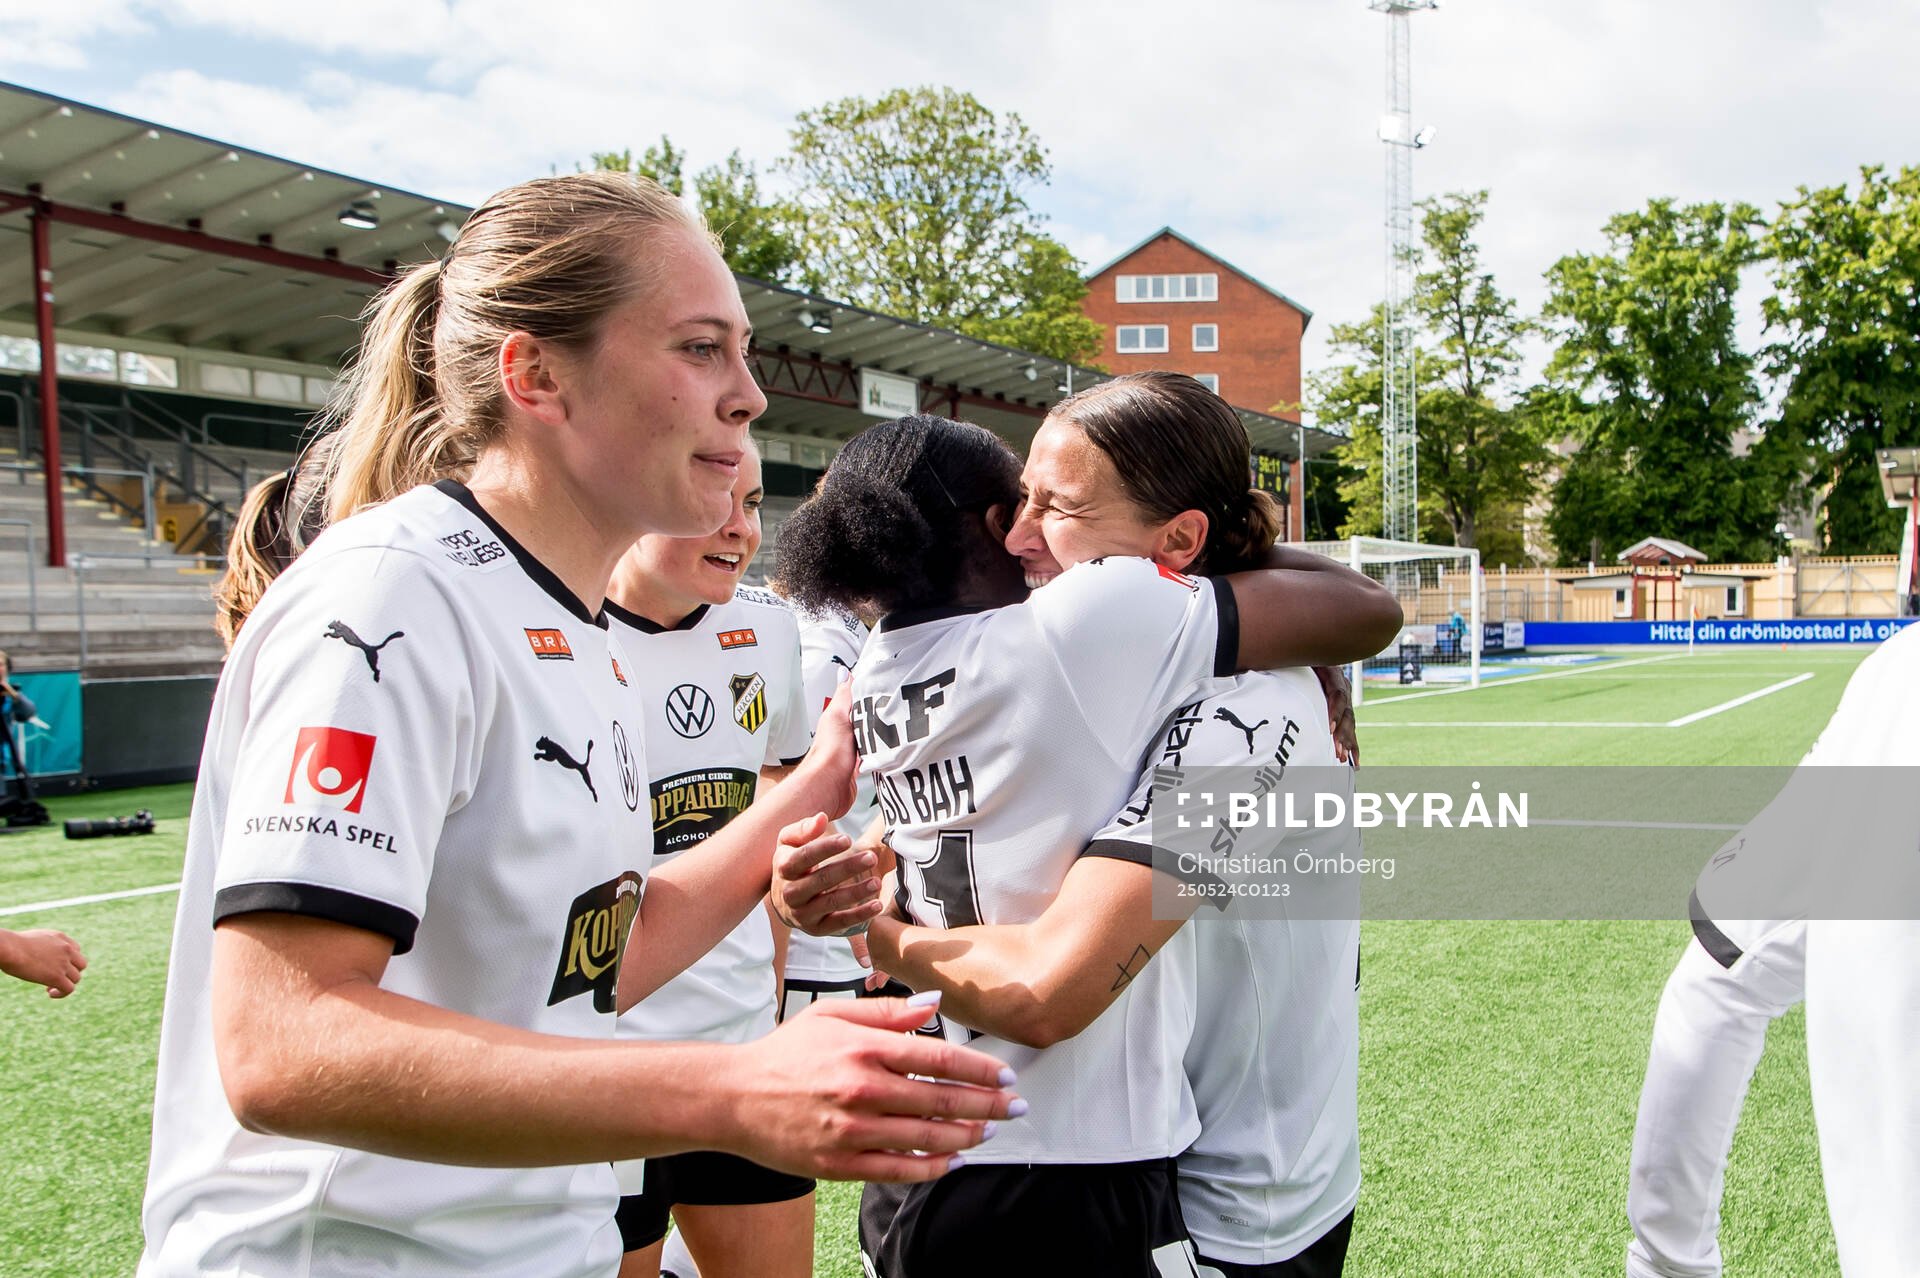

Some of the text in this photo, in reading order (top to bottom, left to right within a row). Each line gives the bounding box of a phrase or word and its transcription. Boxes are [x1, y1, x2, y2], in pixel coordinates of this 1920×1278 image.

[721, 632, 755, 643] BRA
[1650, 623, 1695, 641] Hitta
[1697, 623, 1726, 641] din
[1729, 622, 1846, 641] drömbostad
[1849, 620, 1874, 642] på
[530, 636, 568, 648] BRA
[662, 773, 706, 791] PREMIUM
[903, 755, 976, 823] BAH
[244, 815, 398, 854] SVENSKA SPEL
